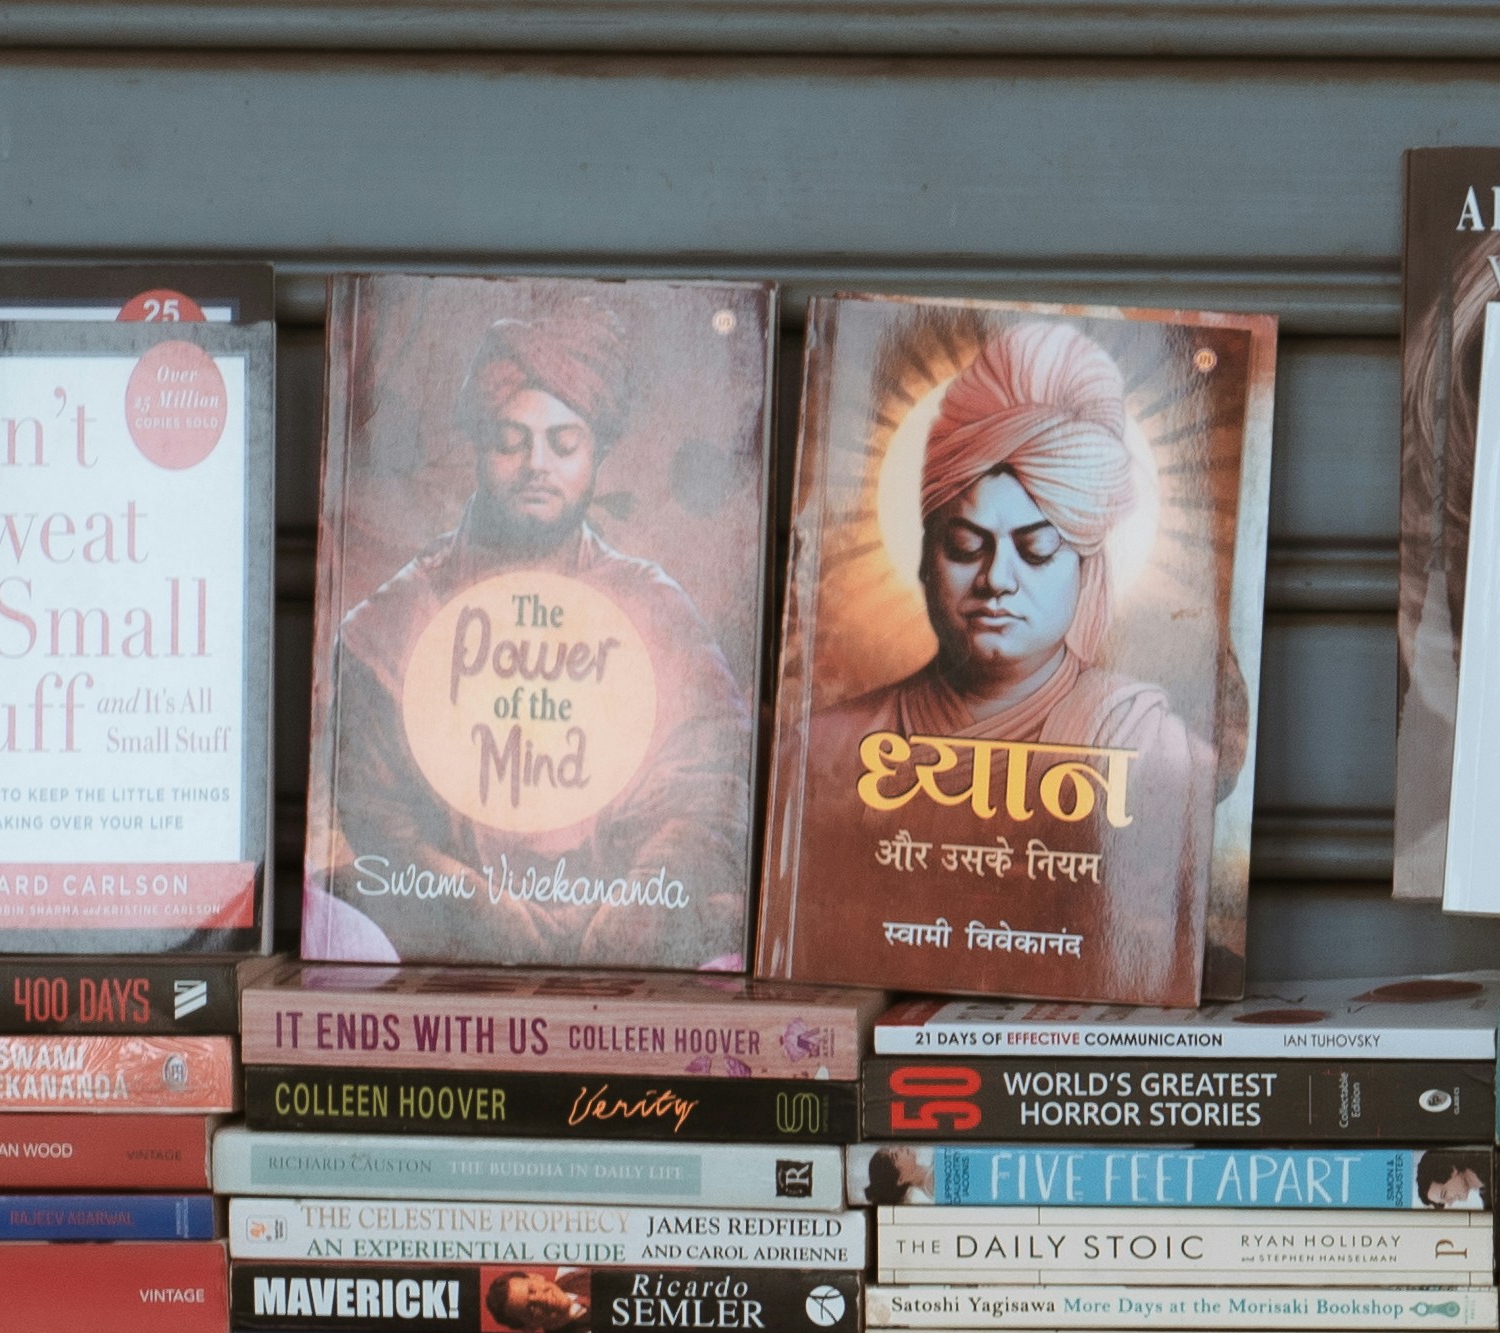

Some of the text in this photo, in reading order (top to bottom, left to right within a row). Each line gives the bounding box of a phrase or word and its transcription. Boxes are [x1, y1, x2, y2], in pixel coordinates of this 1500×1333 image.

[512, 594, 562, 630] The
[451, 607, 620, 706] Power
[494, 690, 572, 721] of the
[471, 723, 589, 808] Mind
[859, 730, 1139, 828] ध्यान
[876, 830, 1104, 883] और उसके नियम
[62, 874, 189, 896] CARLSON
[356, 856, 689, 910] Swami Vivekananda
[884, 920, 1082, 959] स्वामी विवेकानंद
[14, 979, 149, 1023] 400 DAYS
[275, 1083, 506, 1123] COLLEEN HOOVER
[254, 1279, 460, 1320] MAVERICK!
